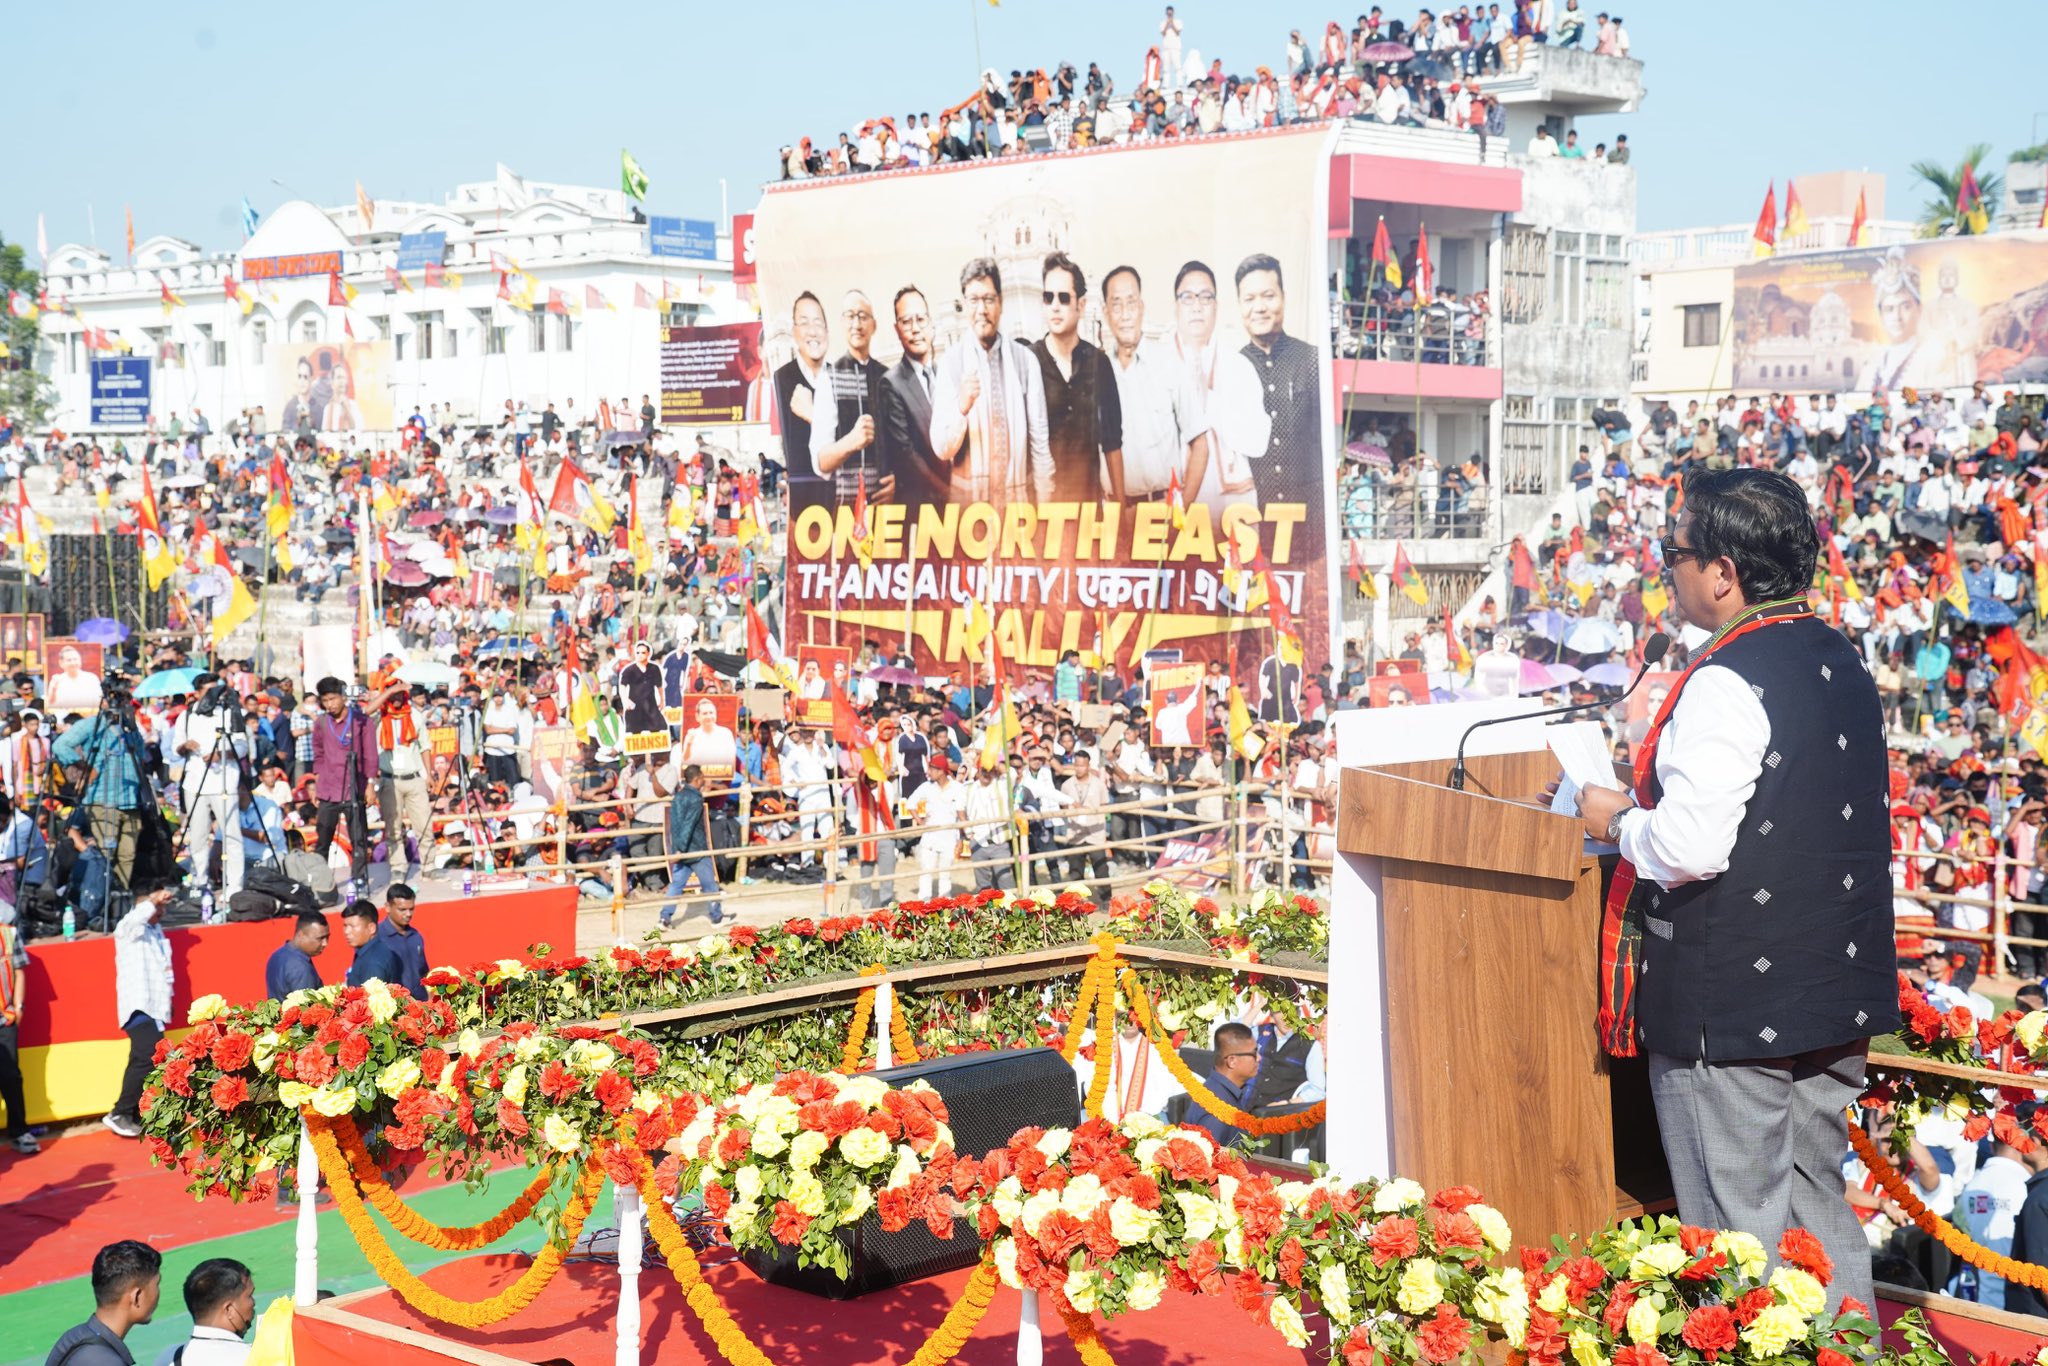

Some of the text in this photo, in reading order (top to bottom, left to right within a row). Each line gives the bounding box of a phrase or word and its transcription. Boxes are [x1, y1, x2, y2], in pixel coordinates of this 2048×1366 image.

[794, 502, 1307, 564] ONE NORTH EAST
[797, 563, 940, 601] THANSA
[949, 565, 1062, 605] UNITY
[1076, 567, 1175, 610] एकता
[945, 608, 1138, 668] RALLY
[625, 733, 669, 753] THANSA
